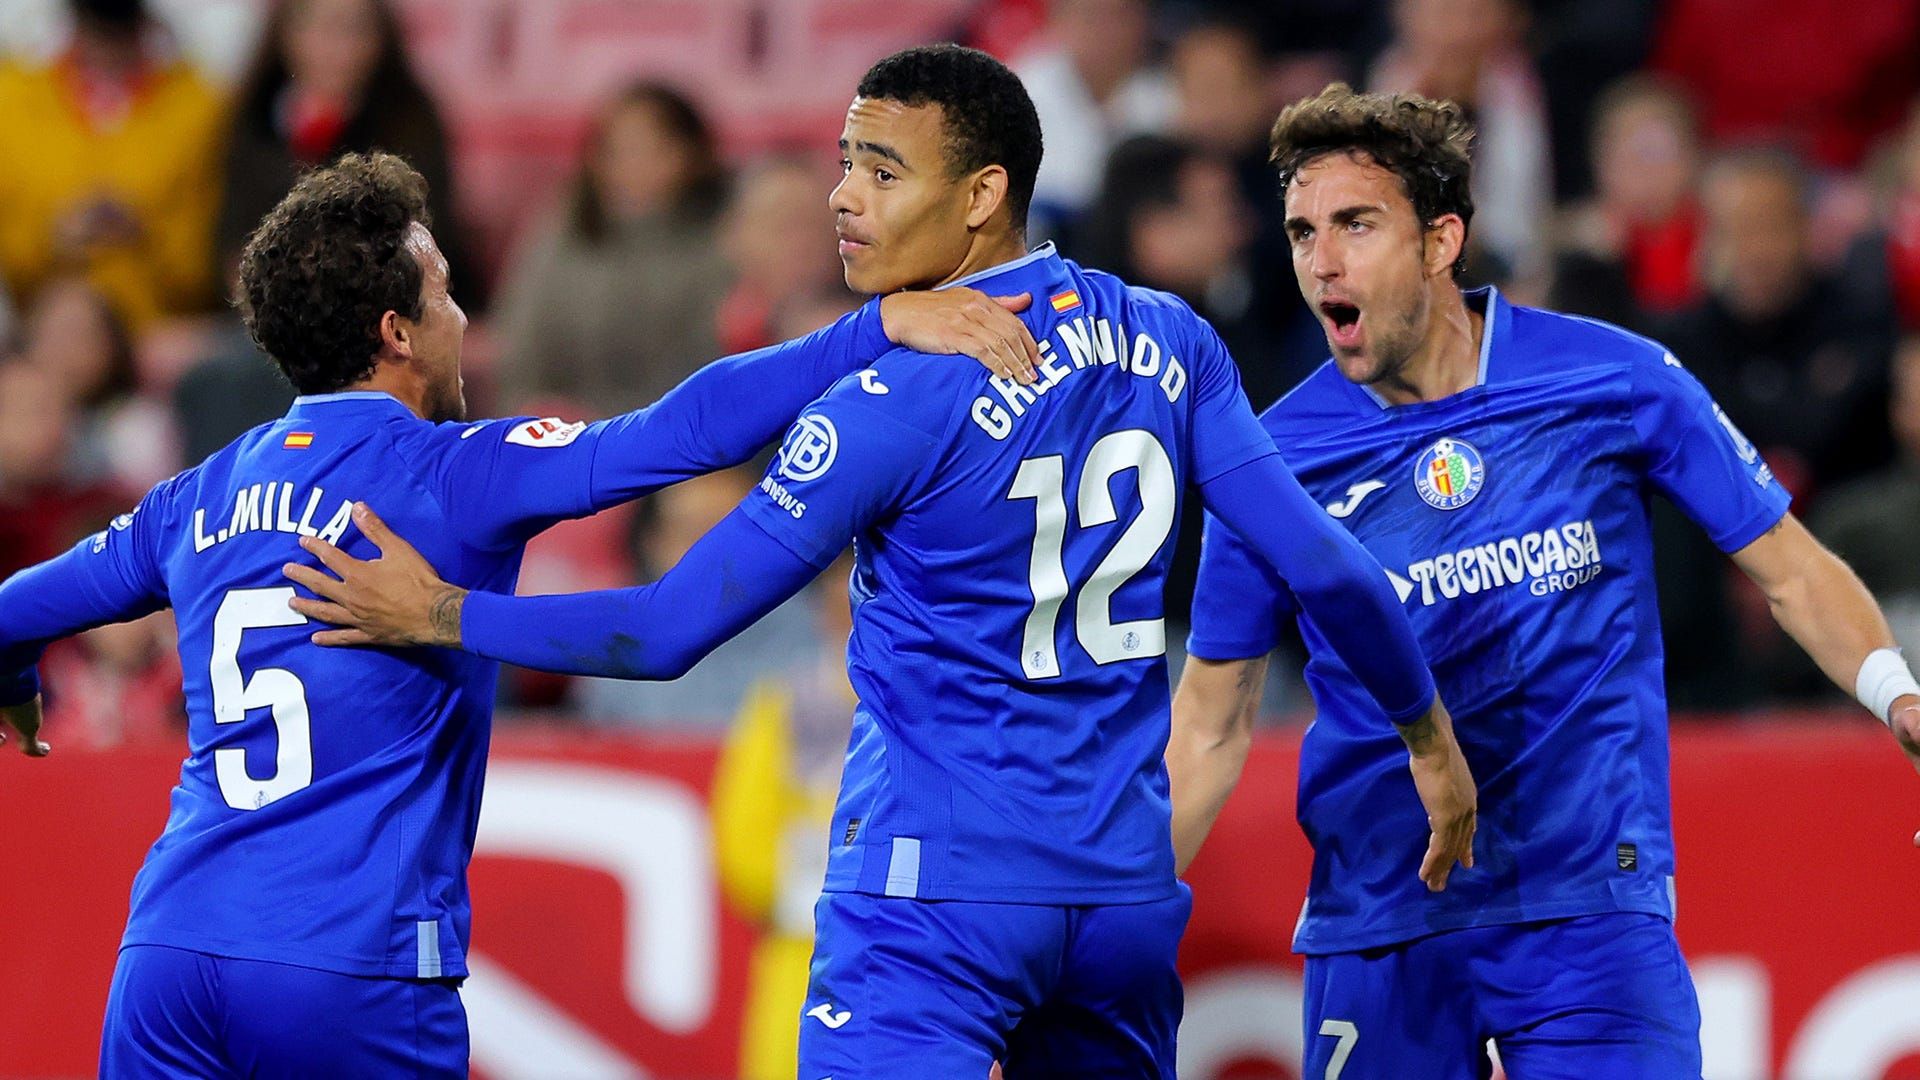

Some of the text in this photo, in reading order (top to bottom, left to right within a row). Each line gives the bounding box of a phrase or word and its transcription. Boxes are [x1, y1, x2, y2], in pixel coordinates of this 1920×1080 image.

[194, 482, 354, 553] L.MILLA
[1419, 480, 1447, 507] GETAFE
[1007, 429, 1176, 680] 12
[1408, 519, 1601, 606] TECNOCASA
[1530, 565, 1602, 596] GROUP
[209, 587, 312, 810] 5
[1318, 1019, 1359, 1080] 7
